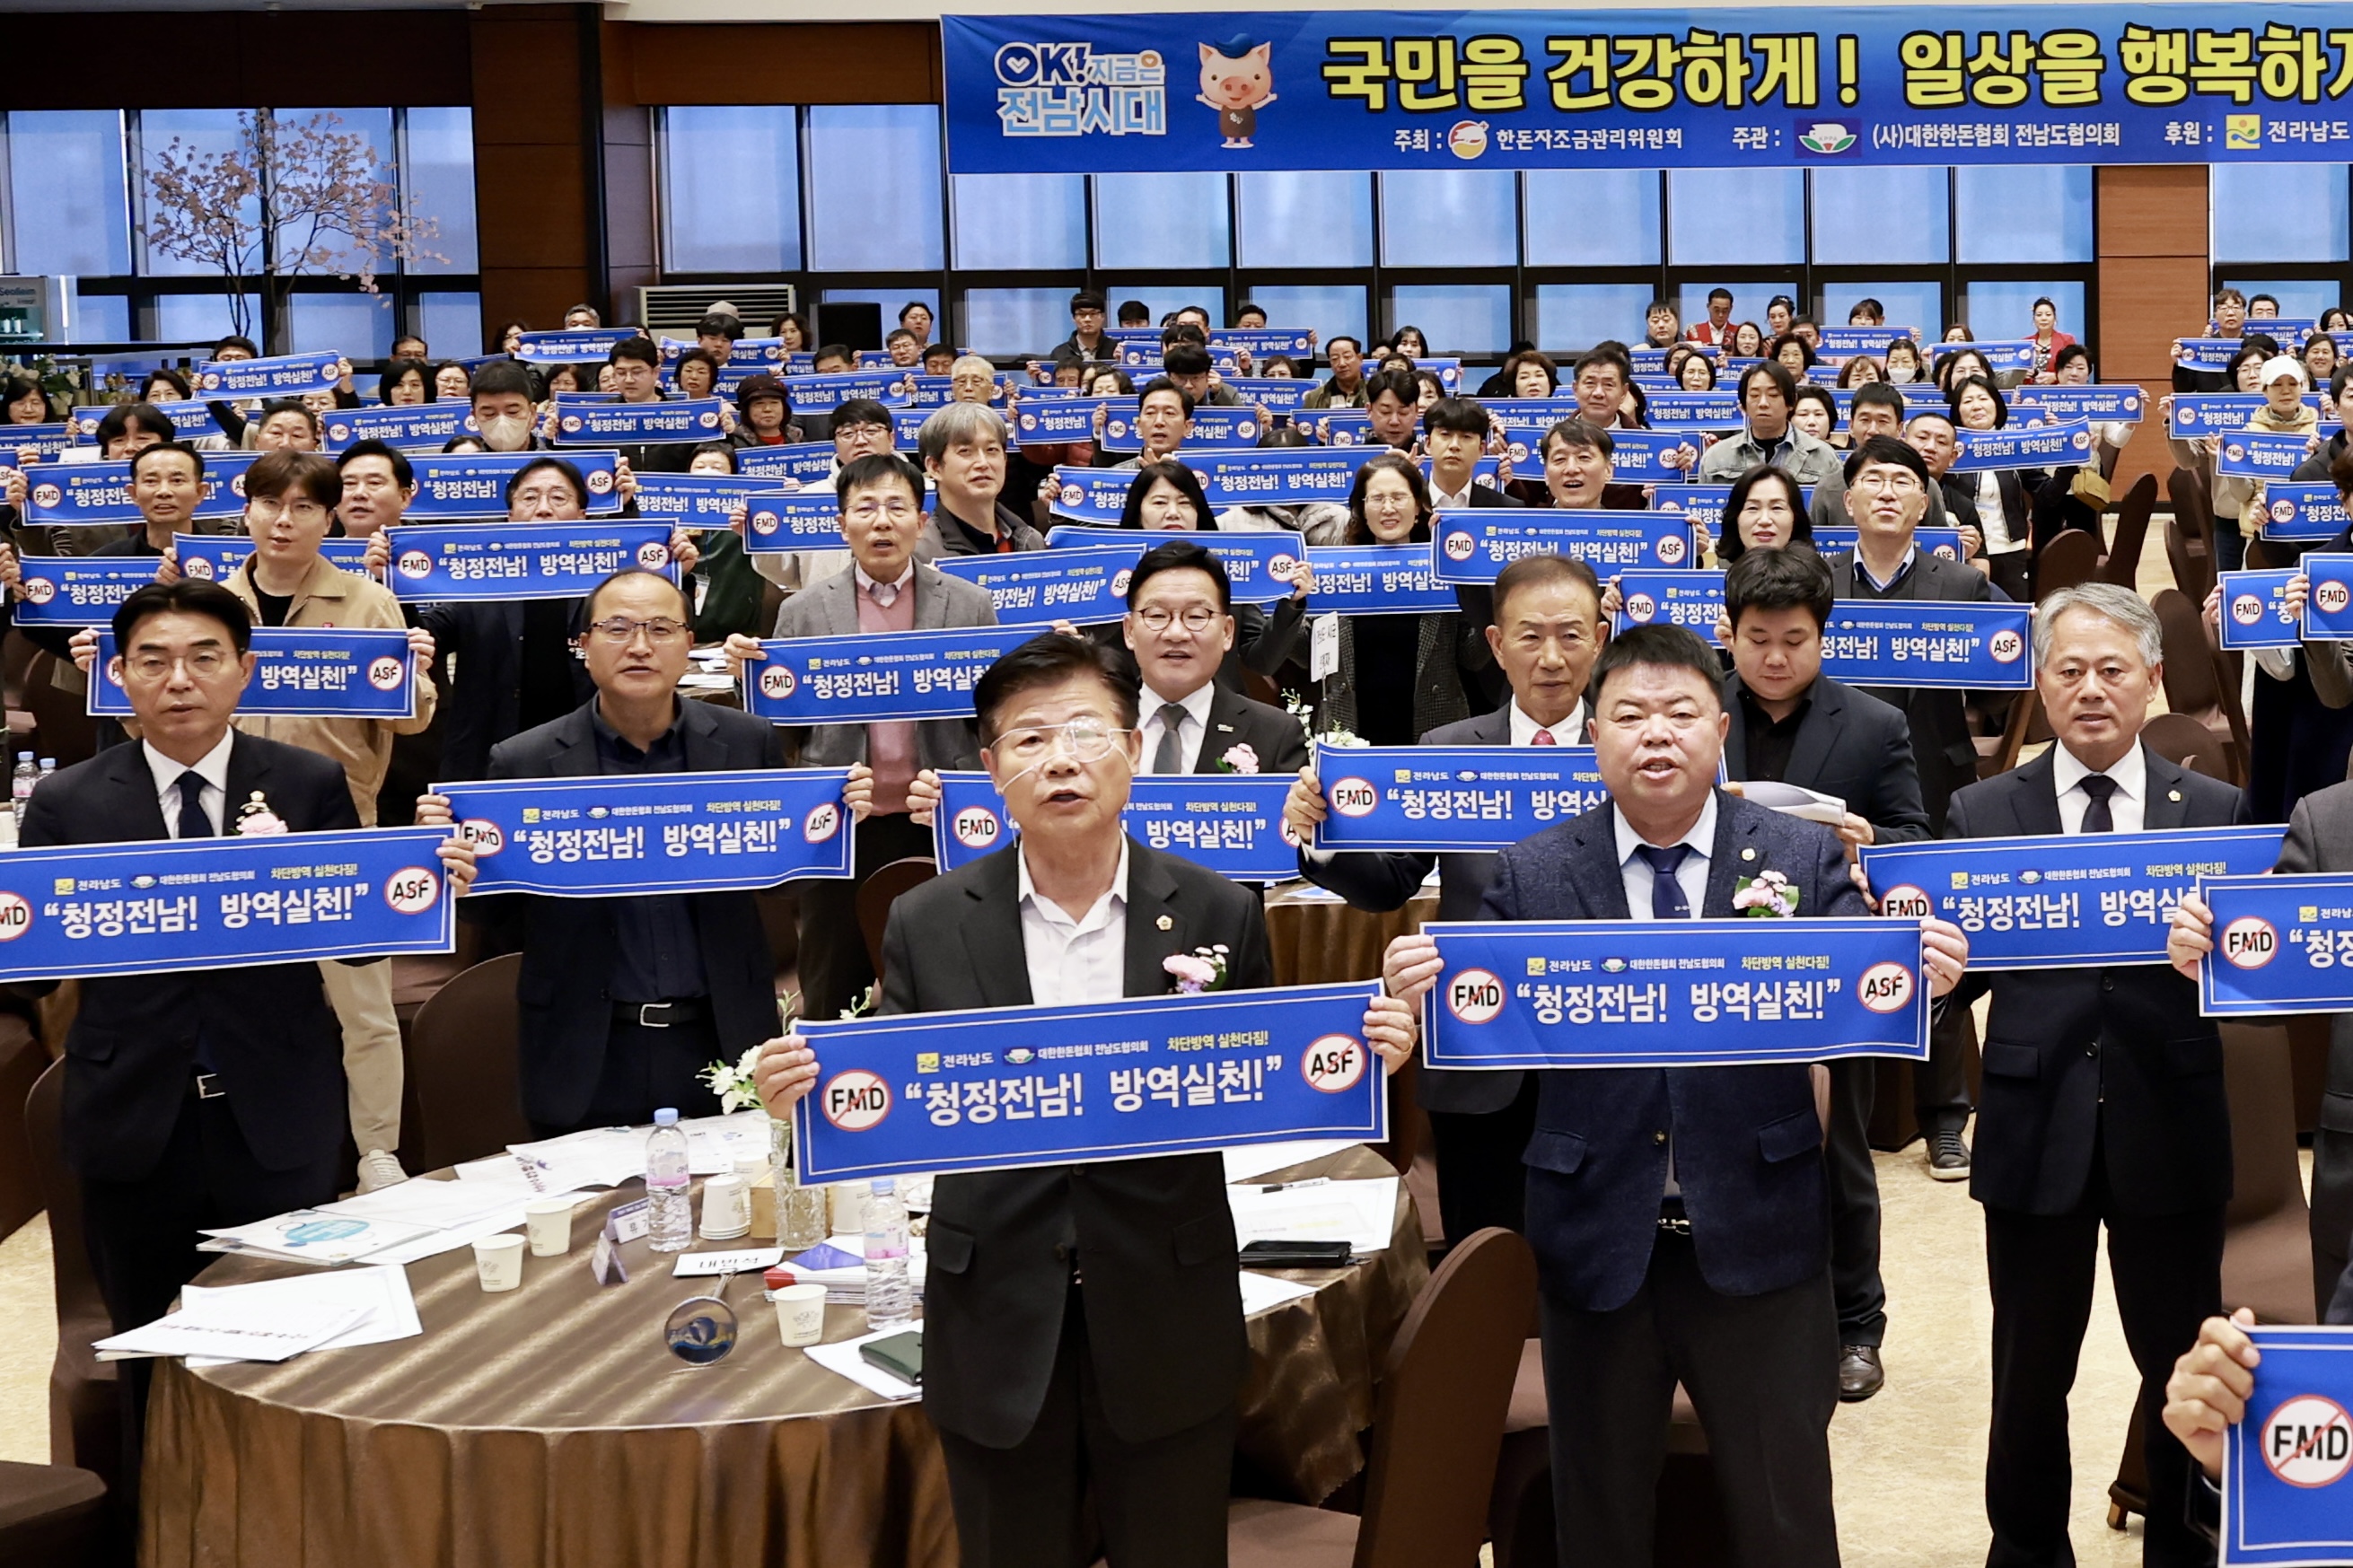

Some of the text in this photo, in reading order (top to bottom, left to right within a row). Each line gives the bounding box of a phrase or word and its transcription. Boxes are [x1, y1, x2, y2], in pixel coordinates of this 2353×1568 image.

[1089, 48, 1167, 88] 지금은
[1323, 39, 1526, 109] 국민을
[1548, 31, 1816, 109] 건강하게
[1901, 33, 2103, 105] 일상을
[997, 84, 1167, 138] 전남시대
[1496, 127, 1682, 151] 한돈자조금관리위원회
[1873, 123, 2009, 150] (사)대한한돈협회
[2015, 122, 2120, 147] 전남도협의회
[2267, 120, 2350, 143] 전라남도
[438, 555, 528, 580] “청정전남!
[540, 550, 628, 576] 방역실천!”
[2321, 590, 2346, 602] FMD
[1891, 636, 2015, 663] 방역실천!” ASF
[260, 665, 397, 691] 방역실천!” ASF
[764, 670, 900, 699] FMD “청정전남!
[1337, 788, 1513, 820] FMD “청정전남!
[514, 826, 645, 864] “청정전남!
[663, 818, 791, 857] 방역실천!”
[960, 819, 995, 835] FMD
[1146, 818, 1267, 850] 방역실천!”
[43, 880, 428, 939] “청정전남! 방역실천!” ASF
[1942, 891, 2080, 932] “청정전남!
[2230, 932, 2272, 952] FMD
[1548, 959, 1593, 973] 전라남도
[1455, 977, 1902, 1024] FMD “청정전남! 방역실천!” ASF
[943, 1052, 995, 1068] 전라남도
[832, 1051, 1352, 1126] FMD “청정전남! 방역실천!” ASF
[2274, 1426, 2348, 1460] FMD
